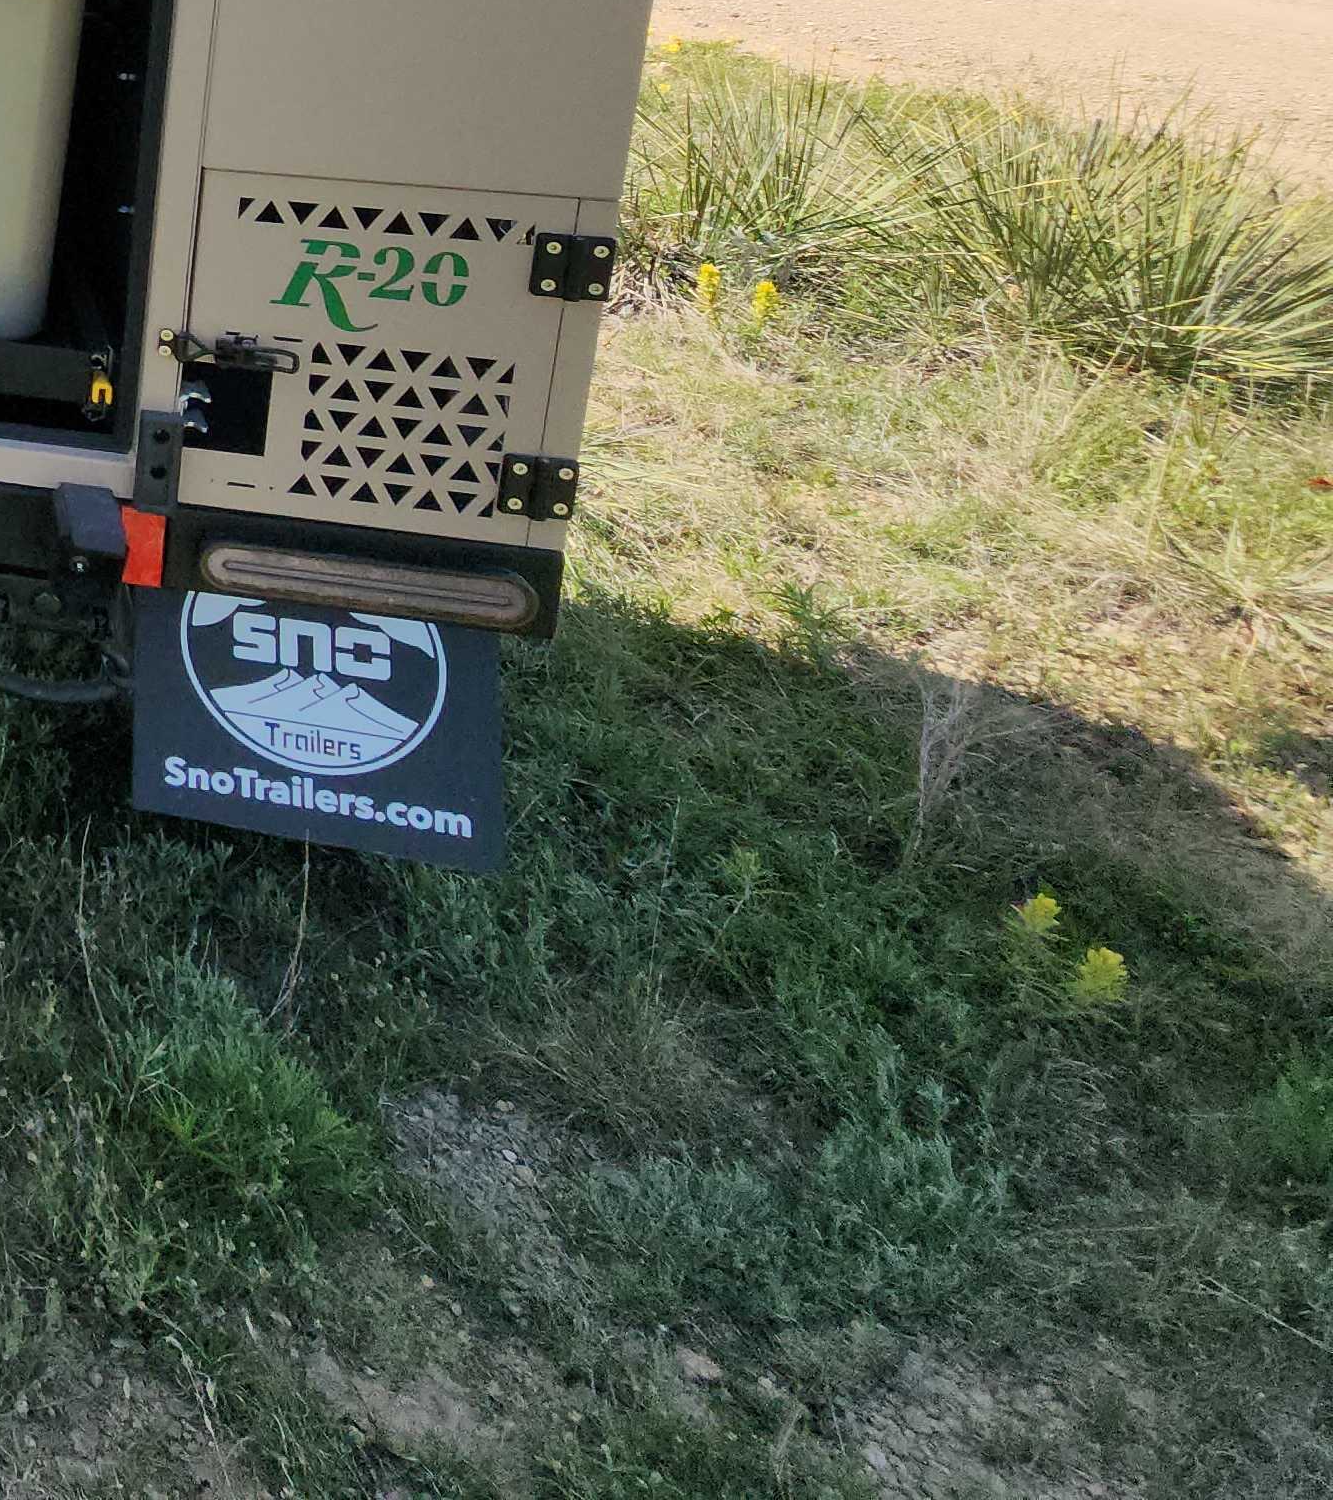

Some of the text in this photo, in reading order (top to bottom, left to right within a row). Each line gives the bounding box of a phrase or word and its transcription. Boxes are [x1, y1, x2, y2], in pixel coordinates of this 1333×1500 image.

[269, 238, 470, 333] R-20
[264, 721, 362, 761] Trailers
[163, 755, 474, 839] SnoTrailers.com
